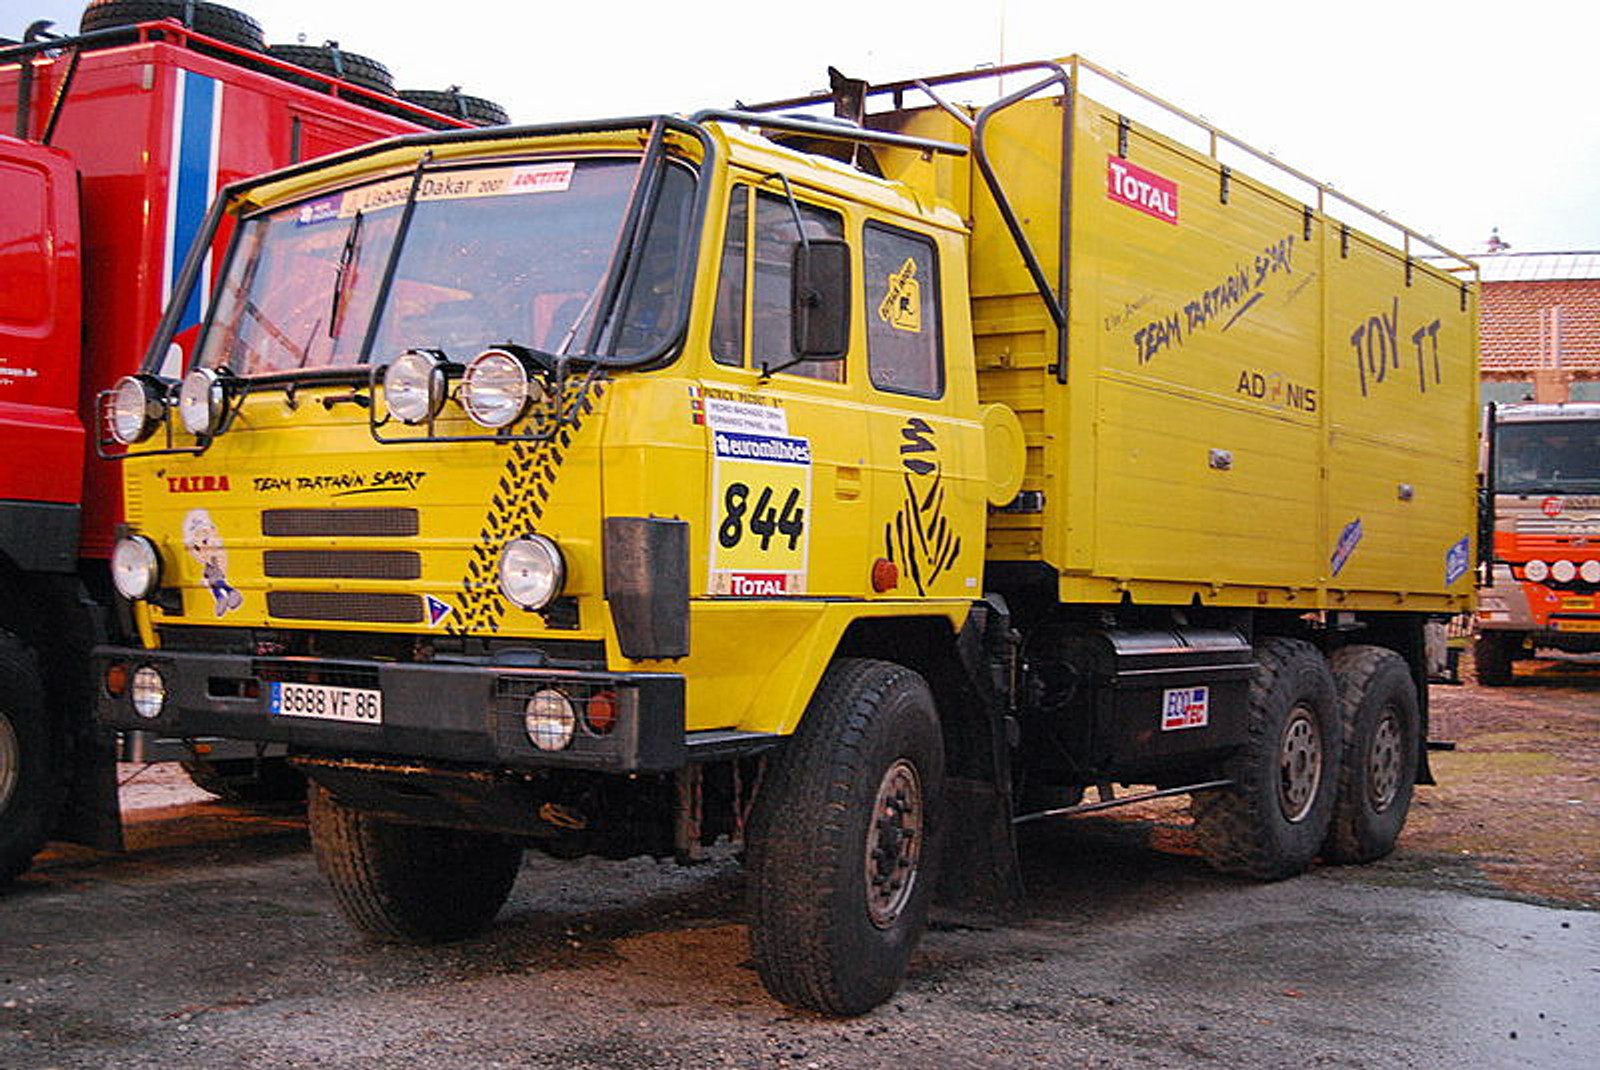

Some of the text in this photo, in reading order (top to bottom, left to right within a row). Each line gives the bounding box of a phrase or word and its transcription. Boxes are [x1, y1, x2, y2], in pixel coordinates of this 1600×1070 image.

[513, 169, 571, 186] LOCTITE
[1110, 162, 1178, 217] TOTAL
[1134, 311, 1183, 366] TEAM
[1184, 262, 1250, 335] TARTARIN
[1350, 296, 1441, 397] TOY TT
[167, 475, 231, 493] TATRA
[253, 470, 427, 492] TEAM TARTARIN SPORT
[718, 482, 804, 552] 844
[731, 576, 786, 595] TOTAL
[284, 687, 378, 719] 8688 VF 86
